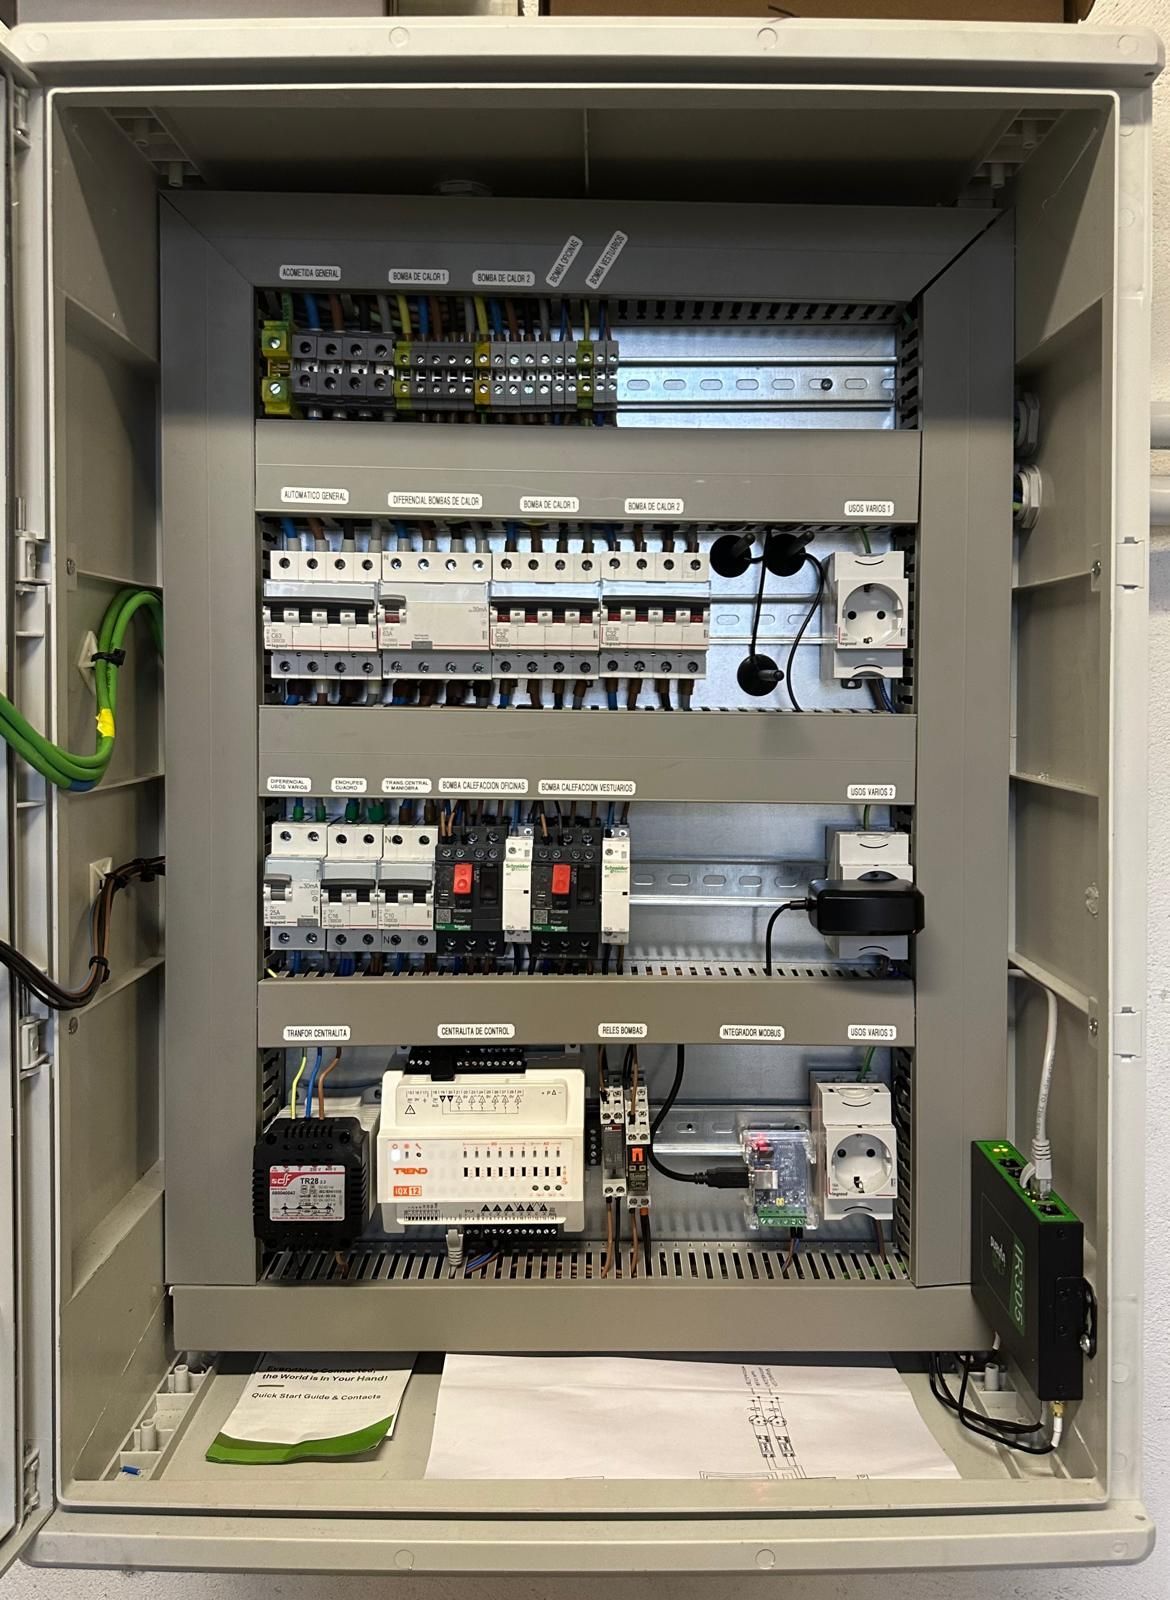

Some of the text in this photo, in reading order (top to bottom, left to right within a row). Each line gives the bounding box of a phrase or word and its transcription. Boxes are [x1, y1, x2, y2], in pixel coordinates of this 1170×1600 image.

[550, 239, 579, 283] BOMBA OFICINAS
[589, 234, 625, 285] BOMBA VESTUARIOS
[283, 268, 340, 278] ACOMETIDA GENERAL
[393, 272, 446, 281] BOMBA DE CALOR 1
[477, 273, 531, 283] BOMBA DE CALOR 2
[284, 490, 347, 501] AUTOMATICO GENERAL
[393, 495, 480, 506] DIFERENCIAL BOMBAS DE CALOR
[523, 500, 576, 509] BOMBA DE CALOR 1
[628, 501, 681, 511] BOMBA DE CALOR 2
[848, 504, 865, 513] USOS
[866, 504, 887, 513] VARIOS
[442, 781, 526, 791] BOMBA CALEFACCION OFICINAS
[541, 782, 633, 793] BOMBA CALEFACCION VESTUARIOS
[850, 787, 894, 797] USOS VARIOS 2
[385, 835, 392, 844] N
[384, 935, 390, 945] N
[287, 1029, 348, 1038] TRANFOR CENTRALITA
[441, 1026, 510, 1036] CENTRALITA DE CONTROL
[602, 1026, 644, 1035] RELES BOMBAS
[722, 1028, 782, 1038] INTEGRADOR MODBUS
[850, 1027, 894, 1037] USOS VARIOS 3
[393, 1167, 428, 1175] TREND
[300, 1177, 319, 1185] TR28
[410, 1187, 420, 1195] 12
[1014, 1243, 1024, 1326] IR305
